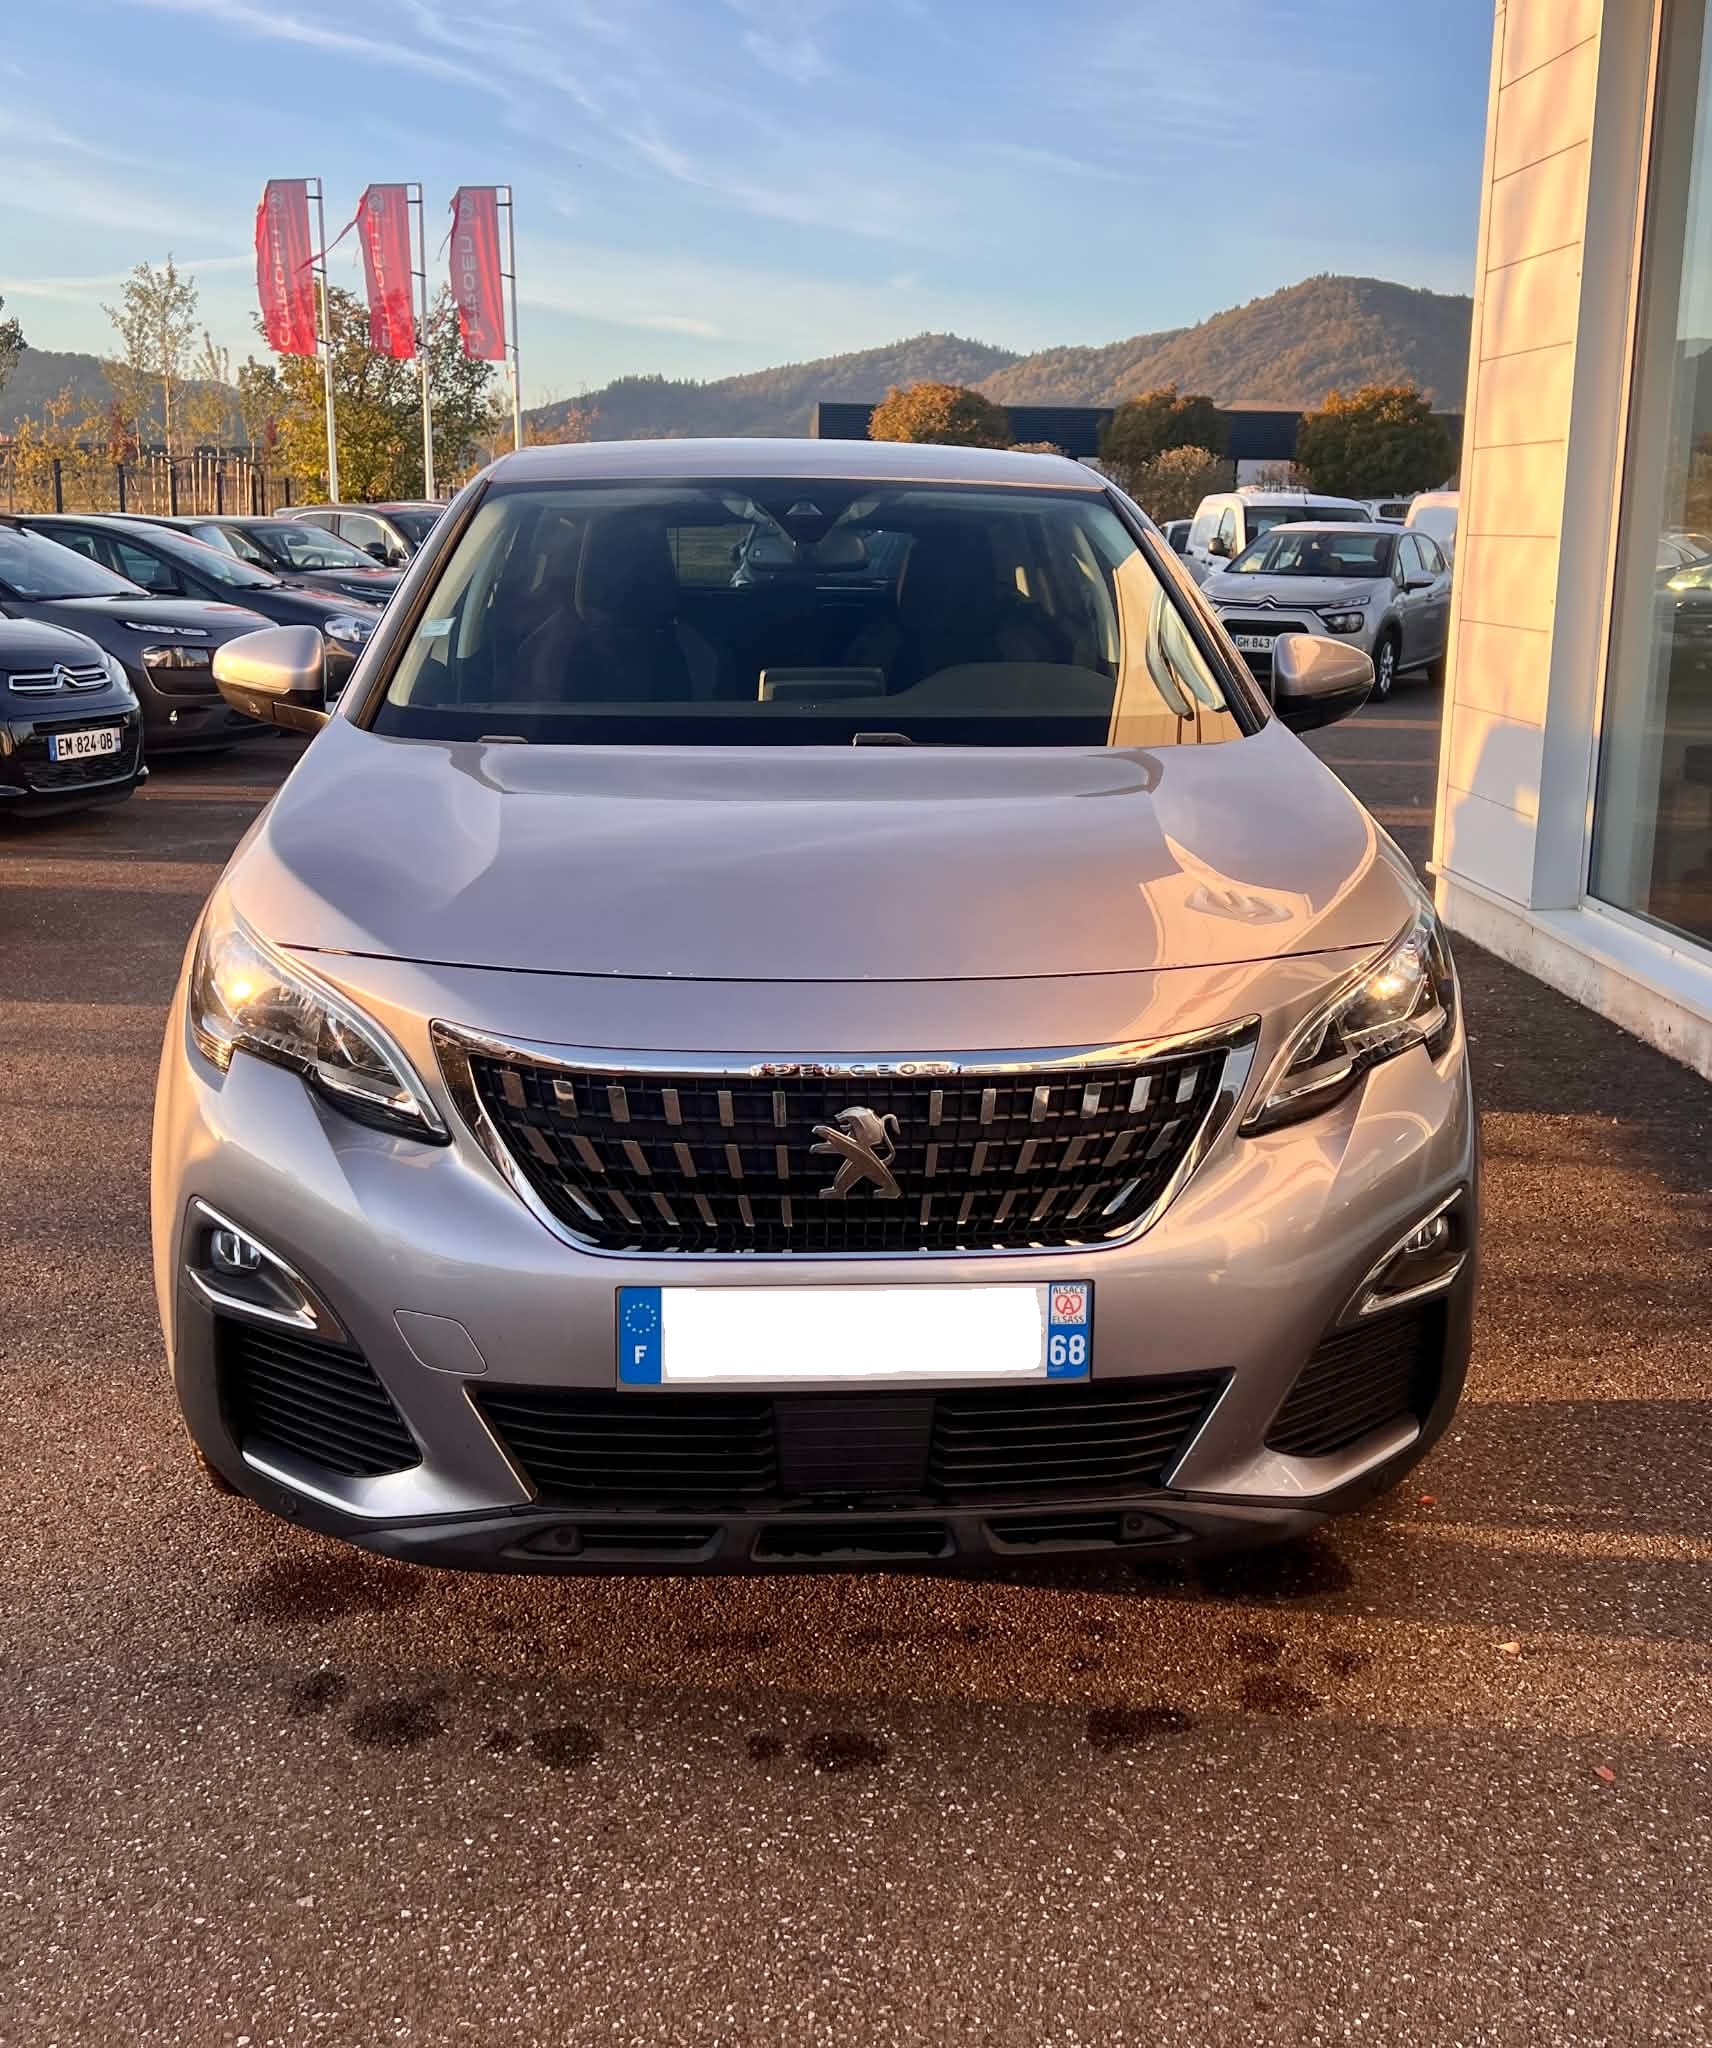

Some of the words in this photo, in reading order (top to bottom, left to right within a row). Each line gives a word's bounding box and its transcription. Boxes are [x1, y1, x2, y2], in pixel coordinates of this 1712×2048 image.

[1053, 1286, 1085, 1294] ALSACE
[1053, 1315, 1085, 1324] ELSASS
[635, 1345, 647, 1364] F
[1050, 1334, 1086, 1365] 68
